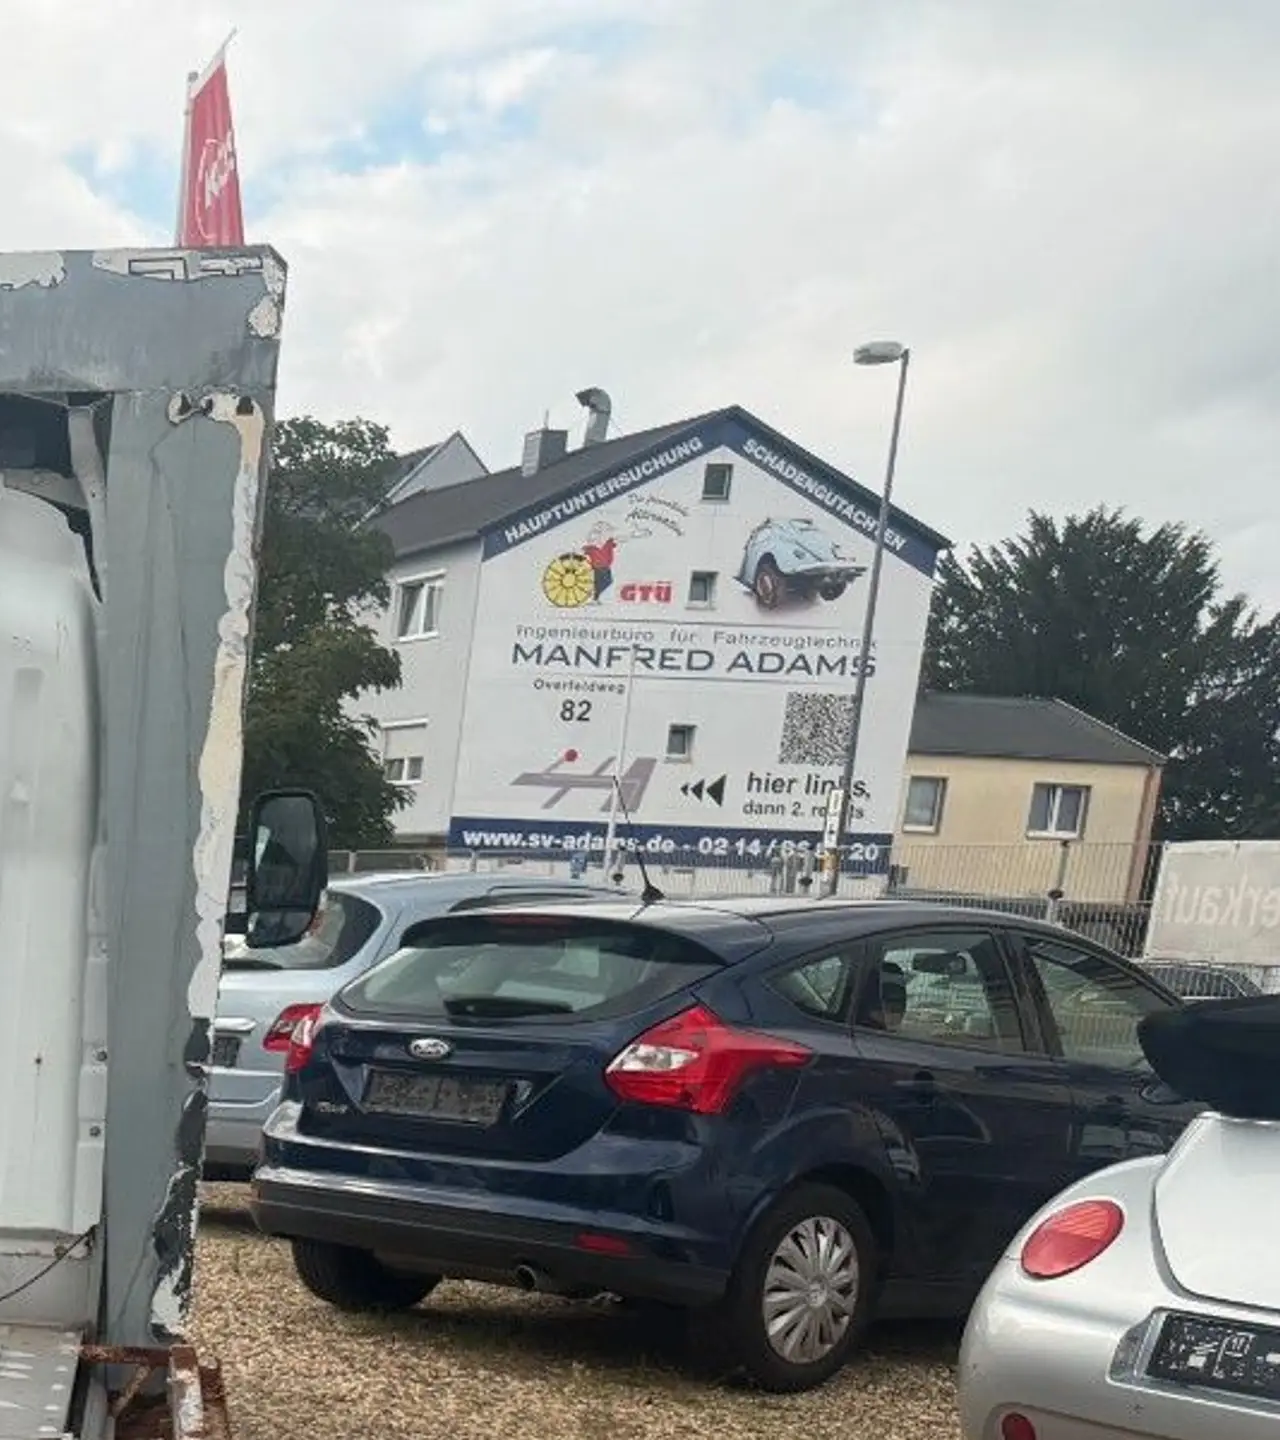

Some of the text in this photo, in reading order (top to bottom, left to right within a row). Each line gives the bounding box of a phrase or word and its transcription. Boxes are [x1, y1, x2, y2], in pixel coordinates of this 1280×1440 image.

[504, 437, 703, 544] HAUPTUNTERSUCHUNG
[713, 631, 878, 650] Fahrzeugtechnk
[512, 643, 878, 678] MANFRED ADAMS
[560, 699, 592, 721] 82
[746, 772, 797, 794] hier
[743, 800, 786, 815] dann
